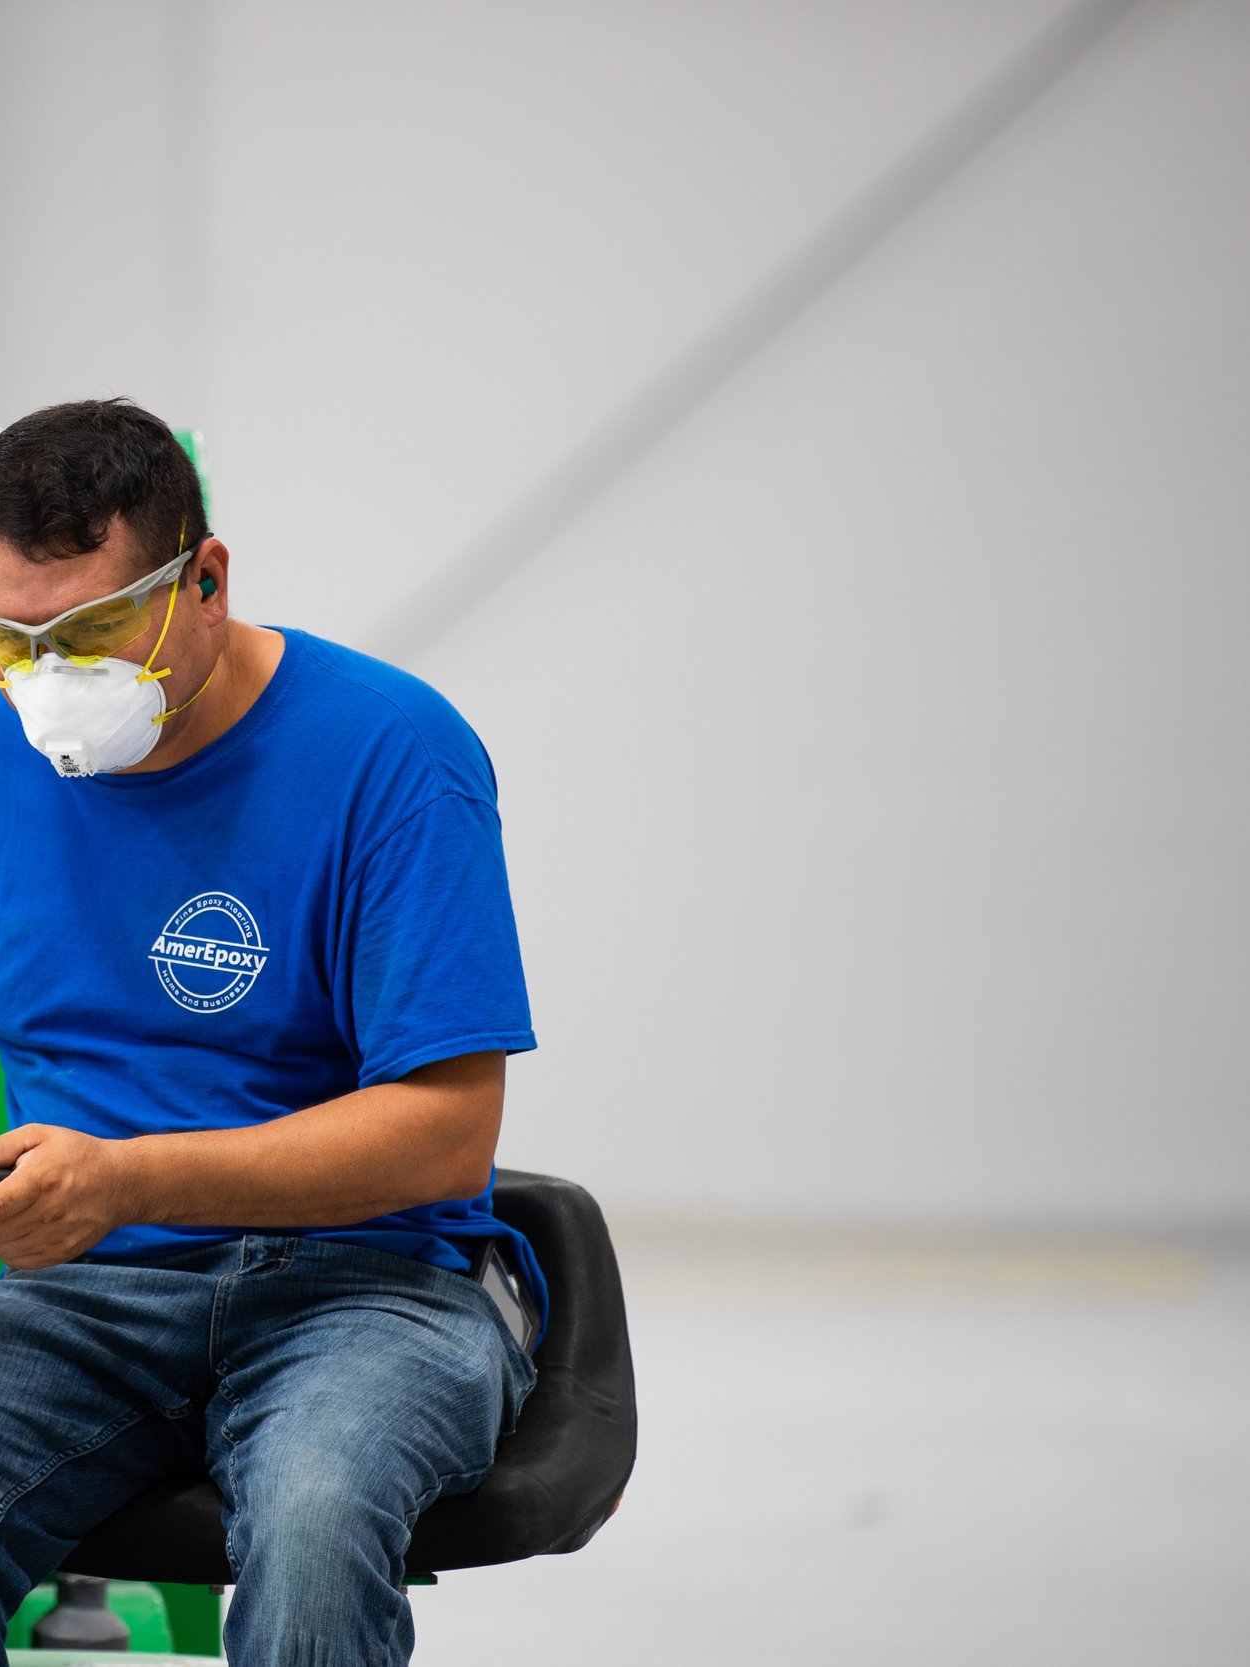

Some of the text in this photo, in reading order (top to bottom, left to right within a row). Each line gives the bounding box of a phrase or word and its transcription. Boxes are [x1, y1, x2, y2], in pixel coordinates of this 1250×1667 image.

[174, 899, 253, 938] Fine Epoxy Flooring
[151, 935, 267, 974] AmerEpoxy
[162, 969, 245, 1007] Home and Business
